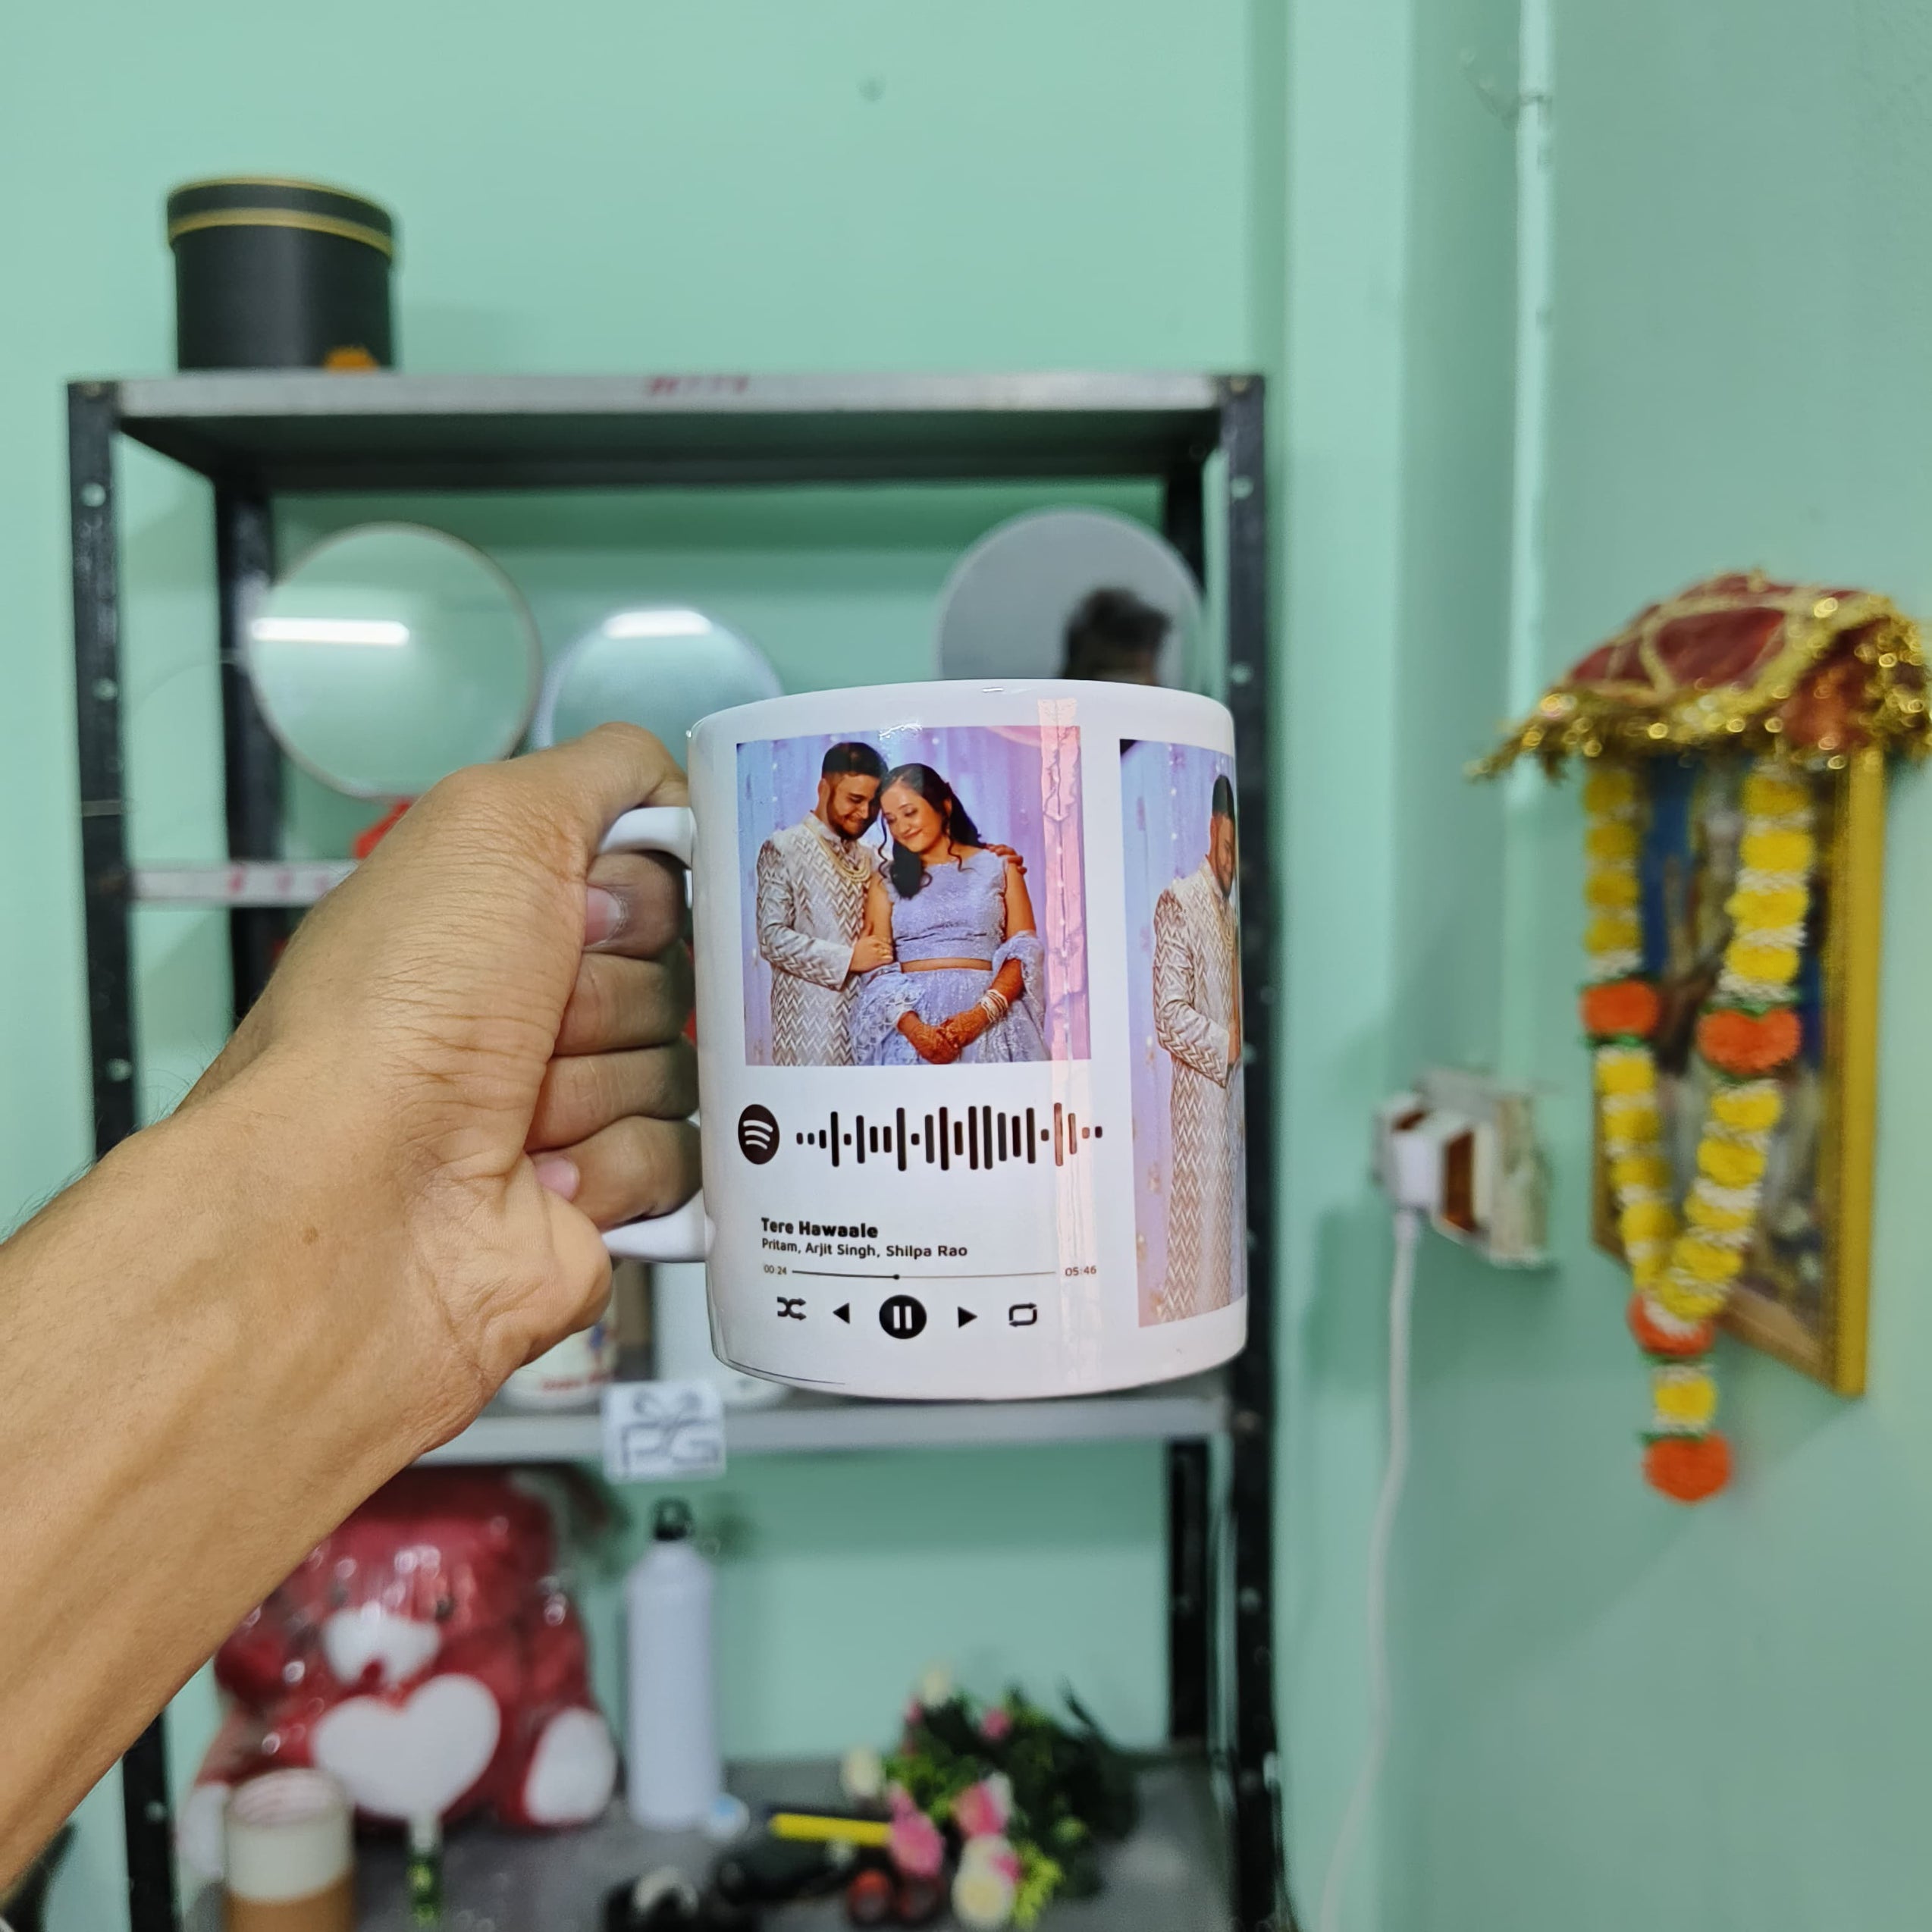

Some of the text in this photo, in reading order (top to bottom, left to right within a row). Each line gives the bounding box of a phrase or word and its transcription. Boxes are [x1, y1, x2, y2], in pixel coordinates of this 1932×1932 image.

[761, 1217, 878, 1238] Tere Hawaale
[762, 1237, 968, 1260] Pritam, Arjit Singh, Shilpa Rao
[1065, 1265, 1097, 1277] 05:46
